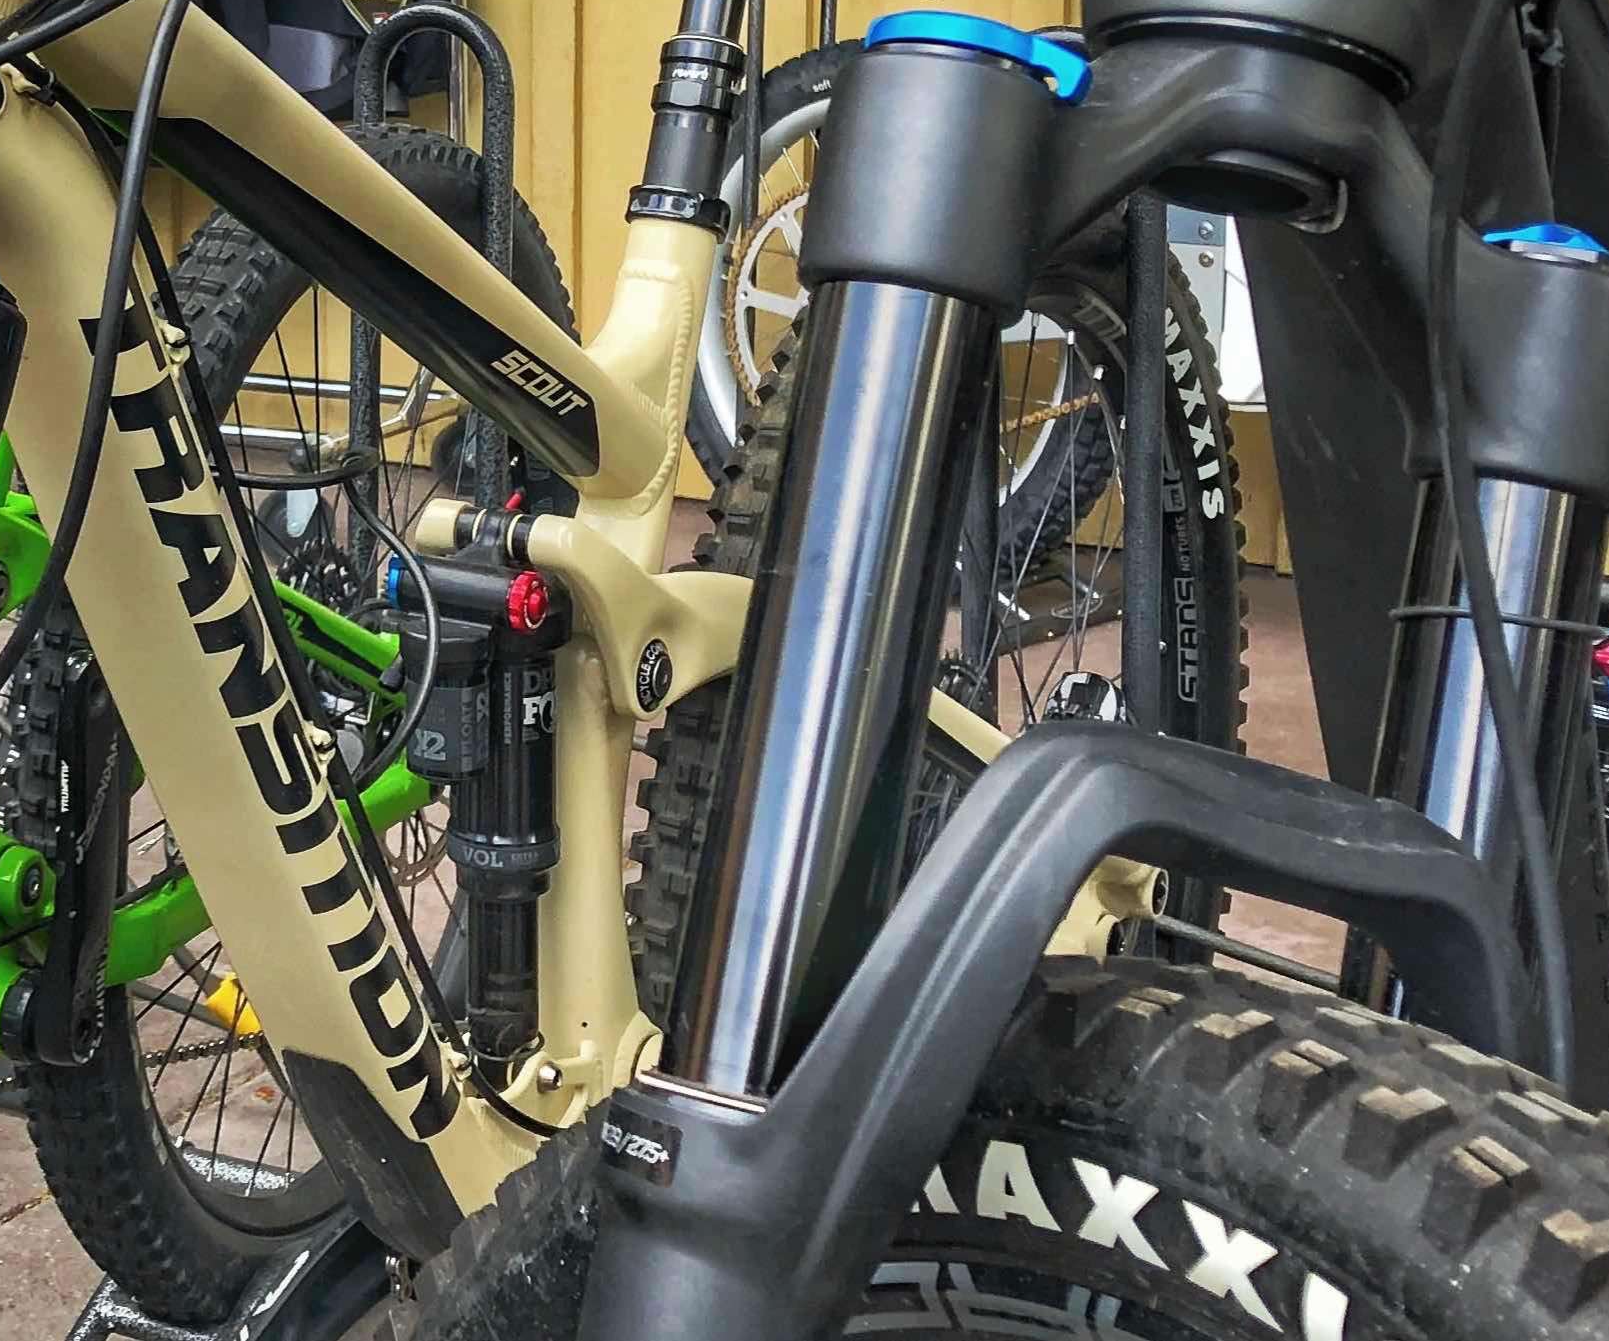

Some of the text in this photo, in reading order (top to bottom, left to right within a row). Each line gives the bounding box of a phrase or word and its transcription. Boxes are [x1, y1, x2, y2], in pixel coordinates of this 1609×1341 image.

[490, 349, 589, 418] SCOUT
[1163, 306, 1226, 521] MAXXIS
[78, 292, 462, 1140] TRANSITION
